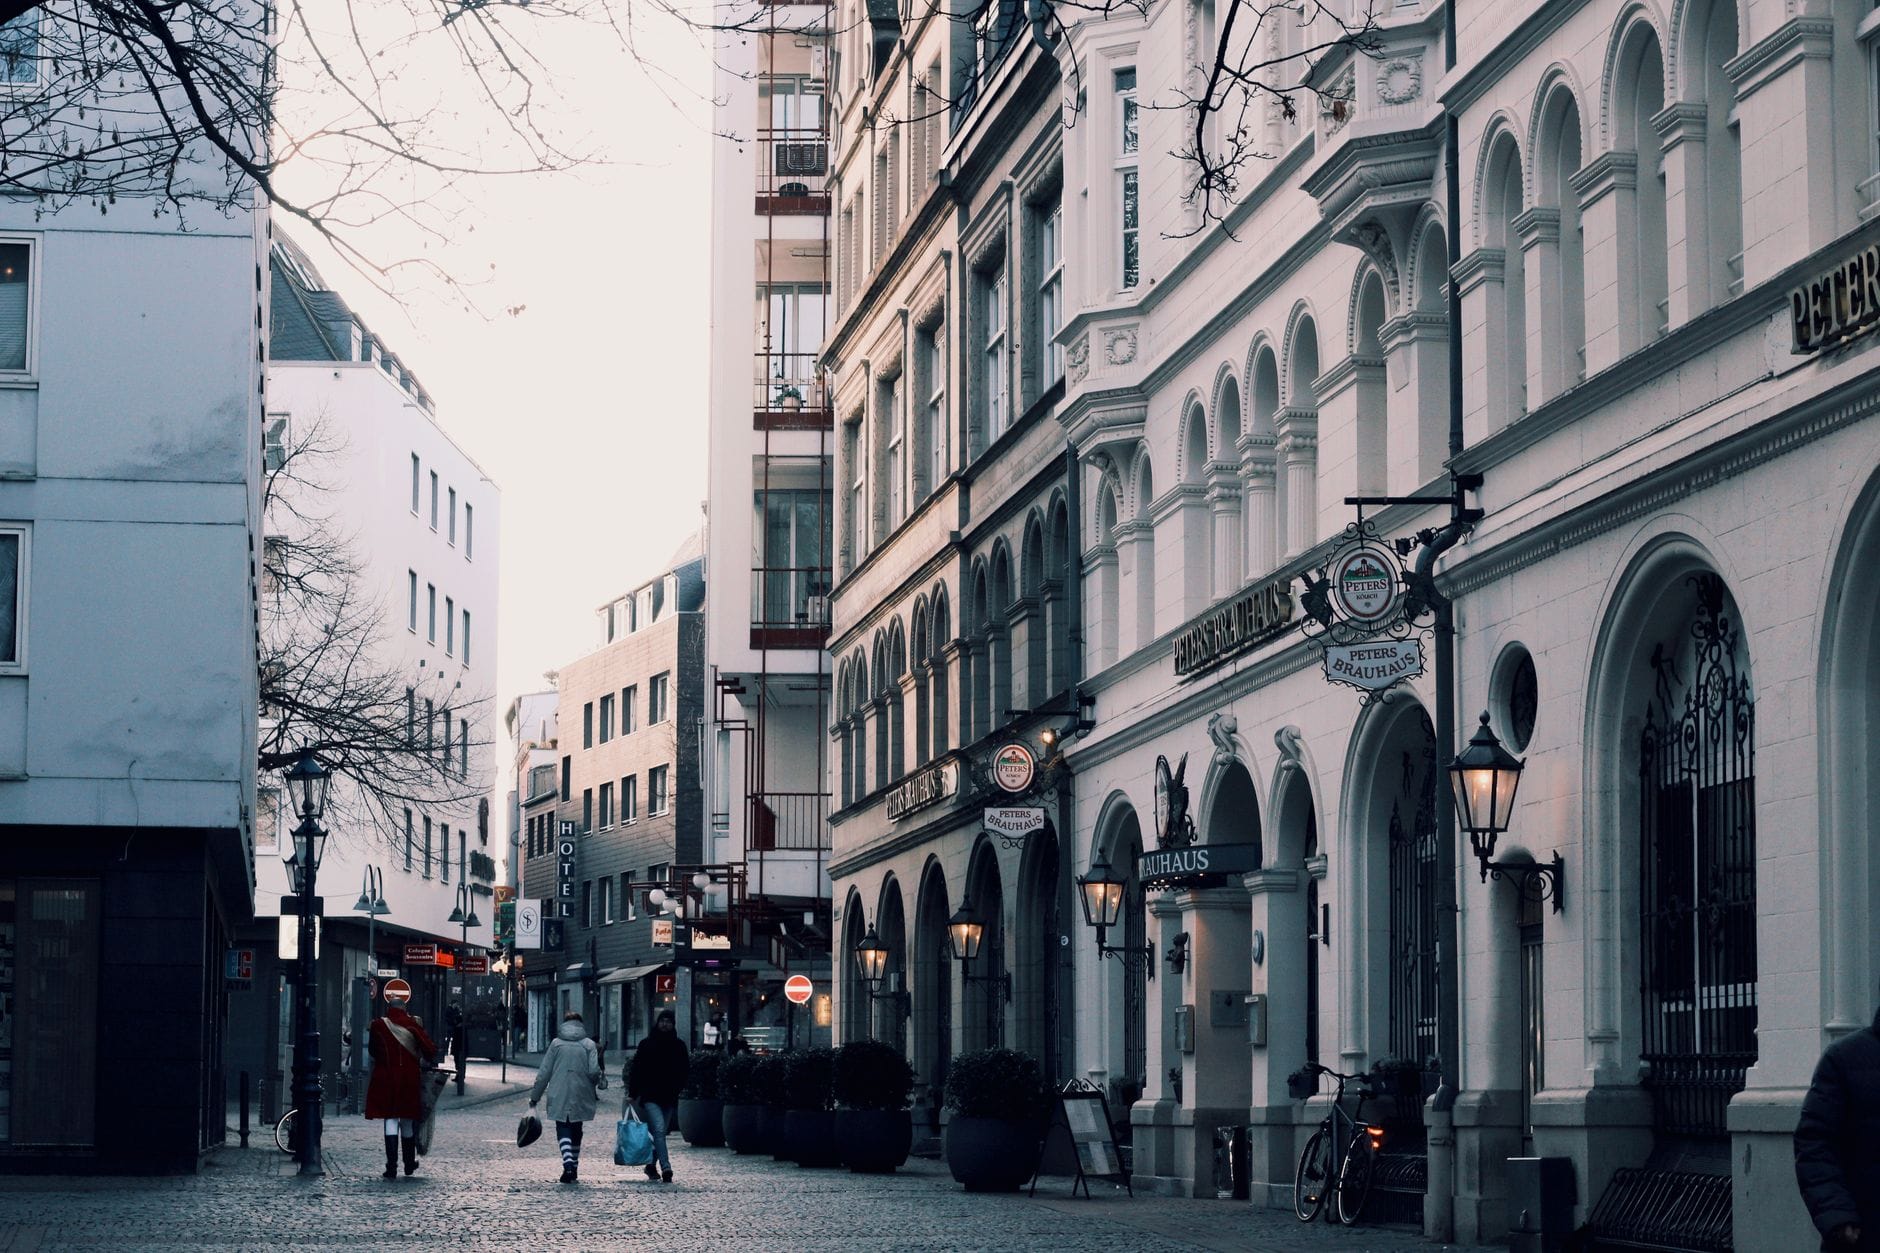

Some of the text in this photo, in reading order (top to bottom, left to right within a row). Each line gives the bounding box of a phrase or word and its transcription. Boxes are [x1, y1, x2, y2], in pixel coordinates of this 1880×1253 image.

[1787, 244, 1880, 354] PETER
[1345, 579, 1388, 592] PETERS
[1172, 581, 1280, 674] PETERS BRAUHAUS
[1350, 647, 1397, 661] PETERS
[1333, 653, 1415, 679] BRAUHAUS
[1000, 764, 1028, 773] PETERS
[987, 816, 1042, 830] BRAUHAUS
[1000, 810, 1031, 819] PETERS
[561, 823, 573, 916] HOTEL
[1139, 849, 1209, 877] RAUHAUS
